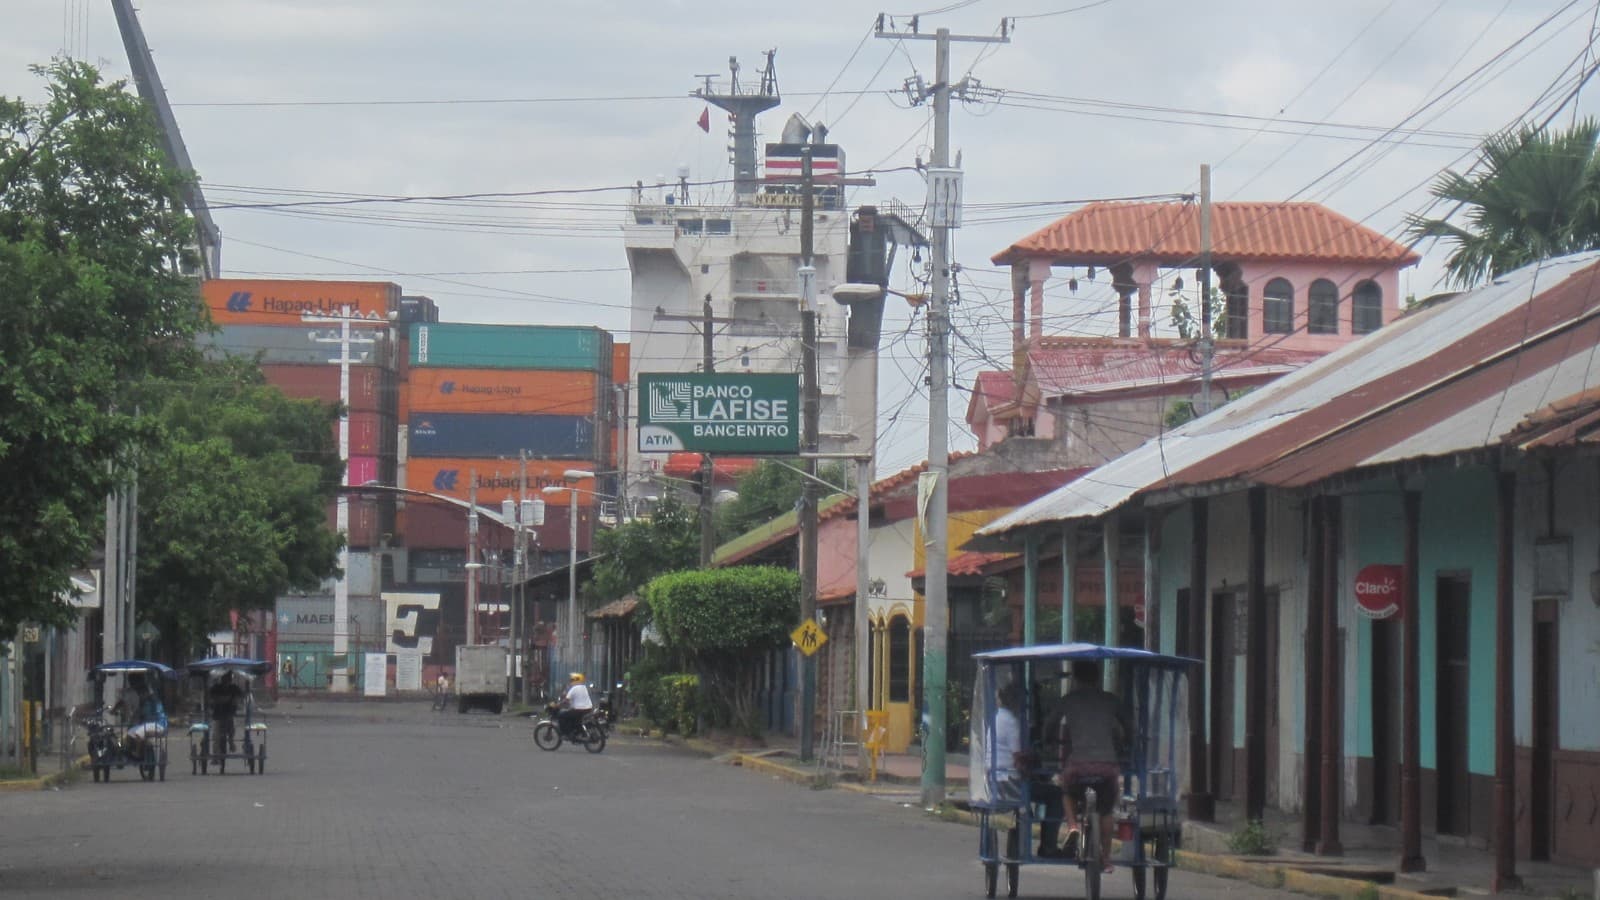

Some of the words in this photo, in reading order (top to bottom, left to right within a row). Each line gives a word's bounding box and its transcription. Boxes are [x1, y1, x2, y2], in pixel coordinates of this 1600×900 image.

[693, 386, 753, 398] BANCO
[693, 400, 788, 420] LAFISE
[693, 425, 789, 437] BANCENTRO
[645, 435, 673, 445] ATM
[1355, 582, 1391, 595] Claro
[296, 614, 359, 624] MAERK
